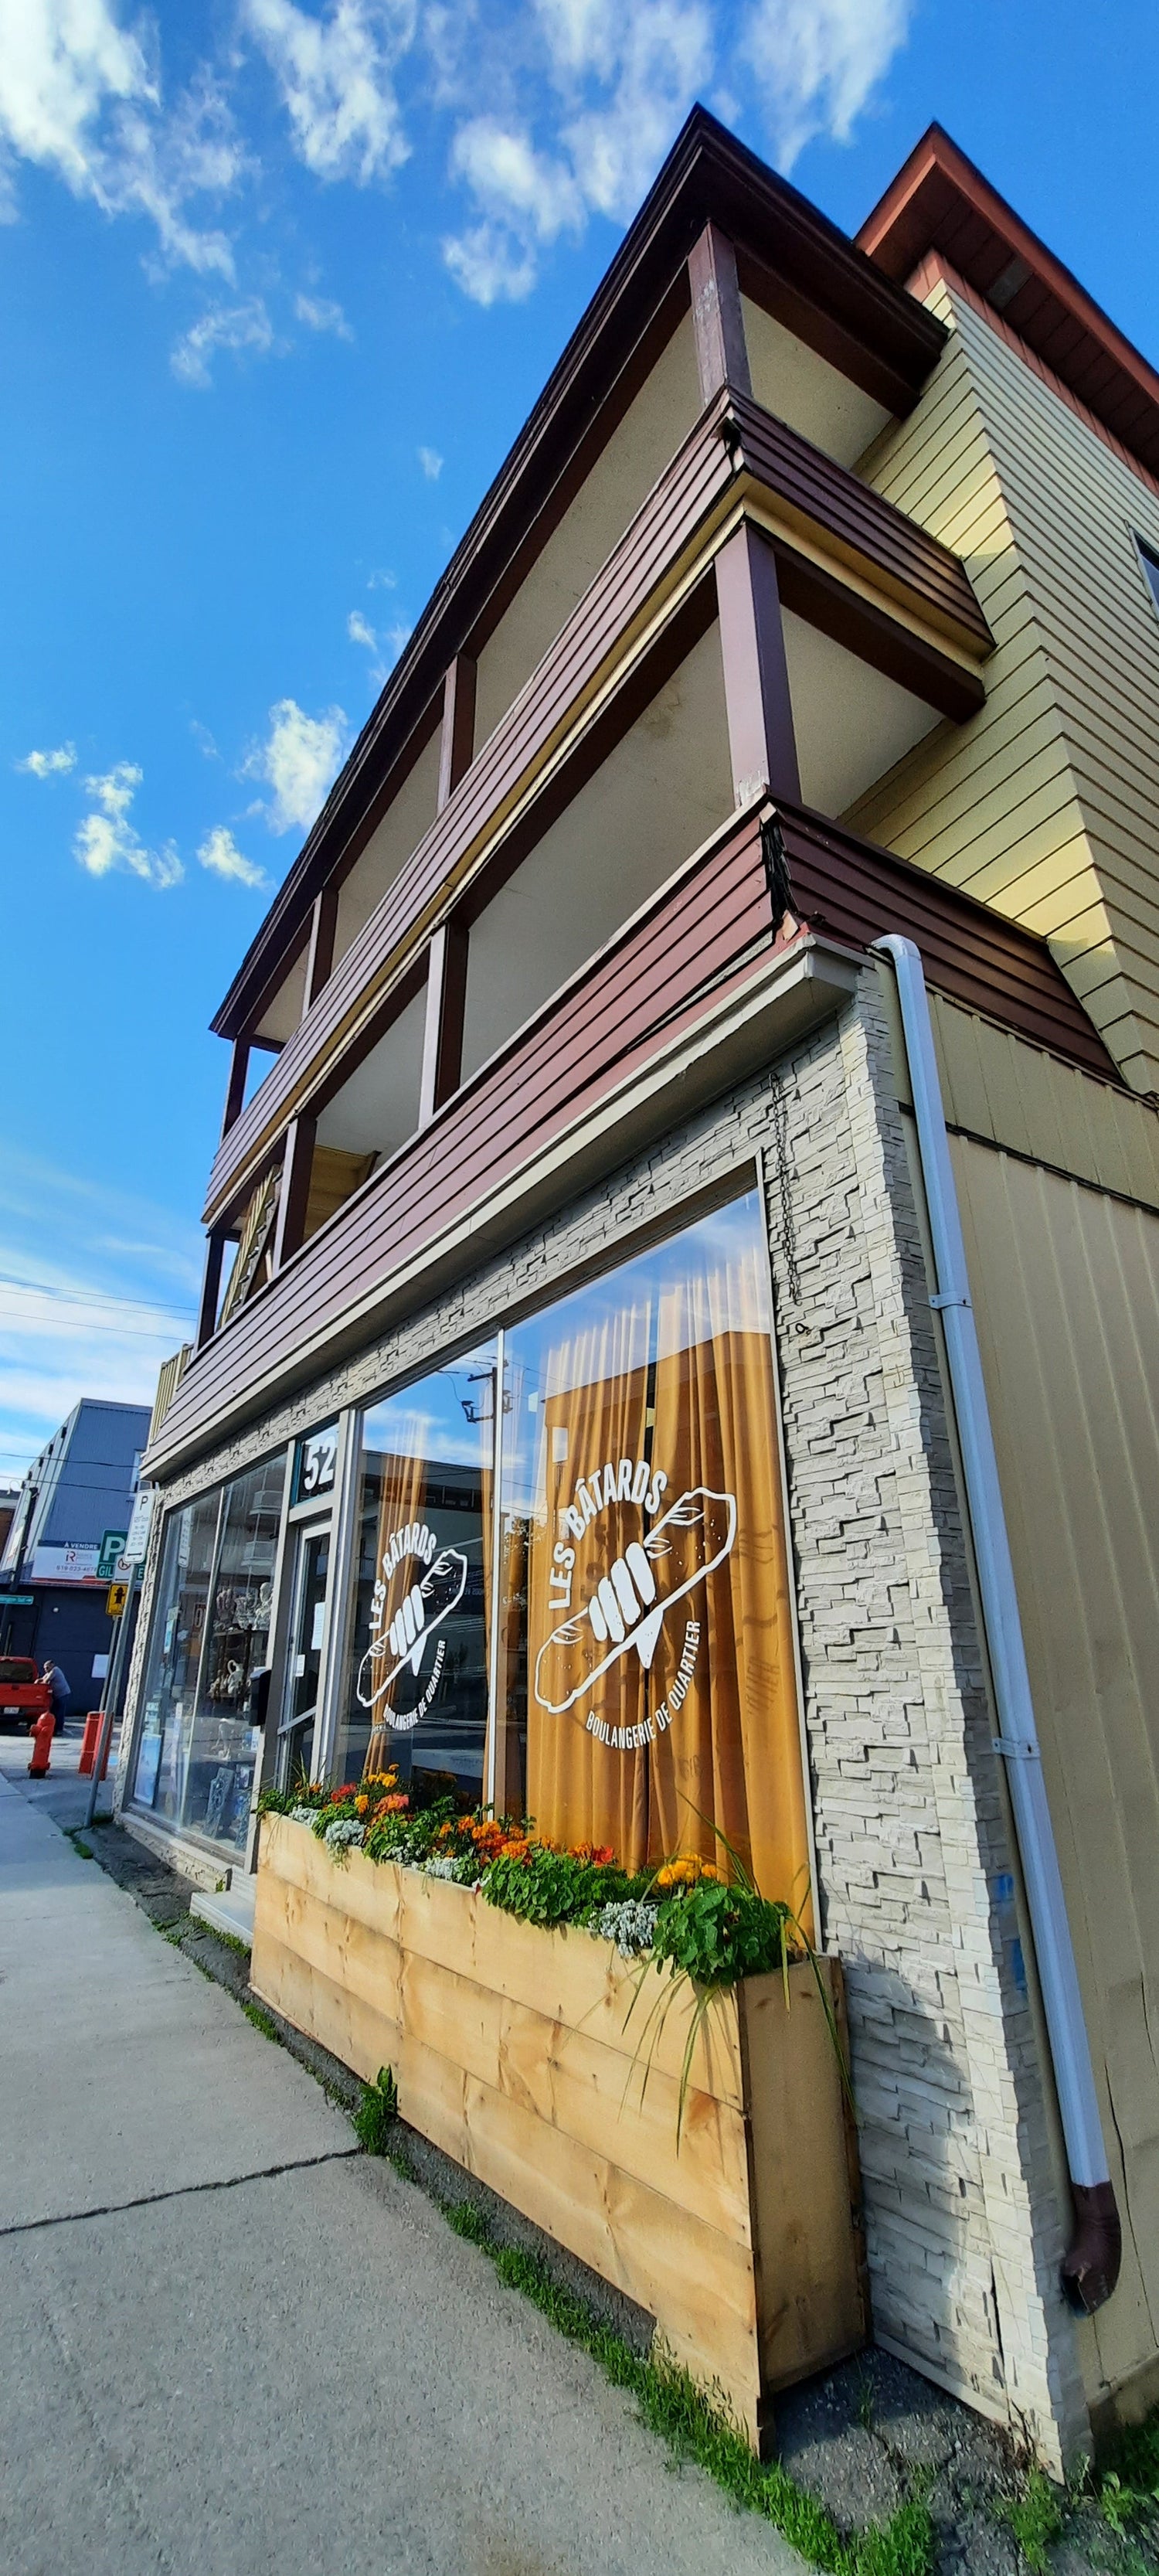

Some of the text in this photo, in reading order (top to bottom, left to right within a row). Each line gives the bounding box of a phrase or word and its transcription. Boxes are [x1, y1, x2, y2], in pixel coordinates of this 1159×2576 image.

[304, 1435, 336, 1490] 52
[103, 1536, 125, 1561] P
[369, 1522, 437, 1630] LES BÂTARDS
[549, 1458, 668, 1609] LES BÂTARDS
[383, 1639, 446, 1730] BOULANGERIE DE QUARTIER
[586, 1620, 700, 1749] BOULANGERIE DE QUARTIER
